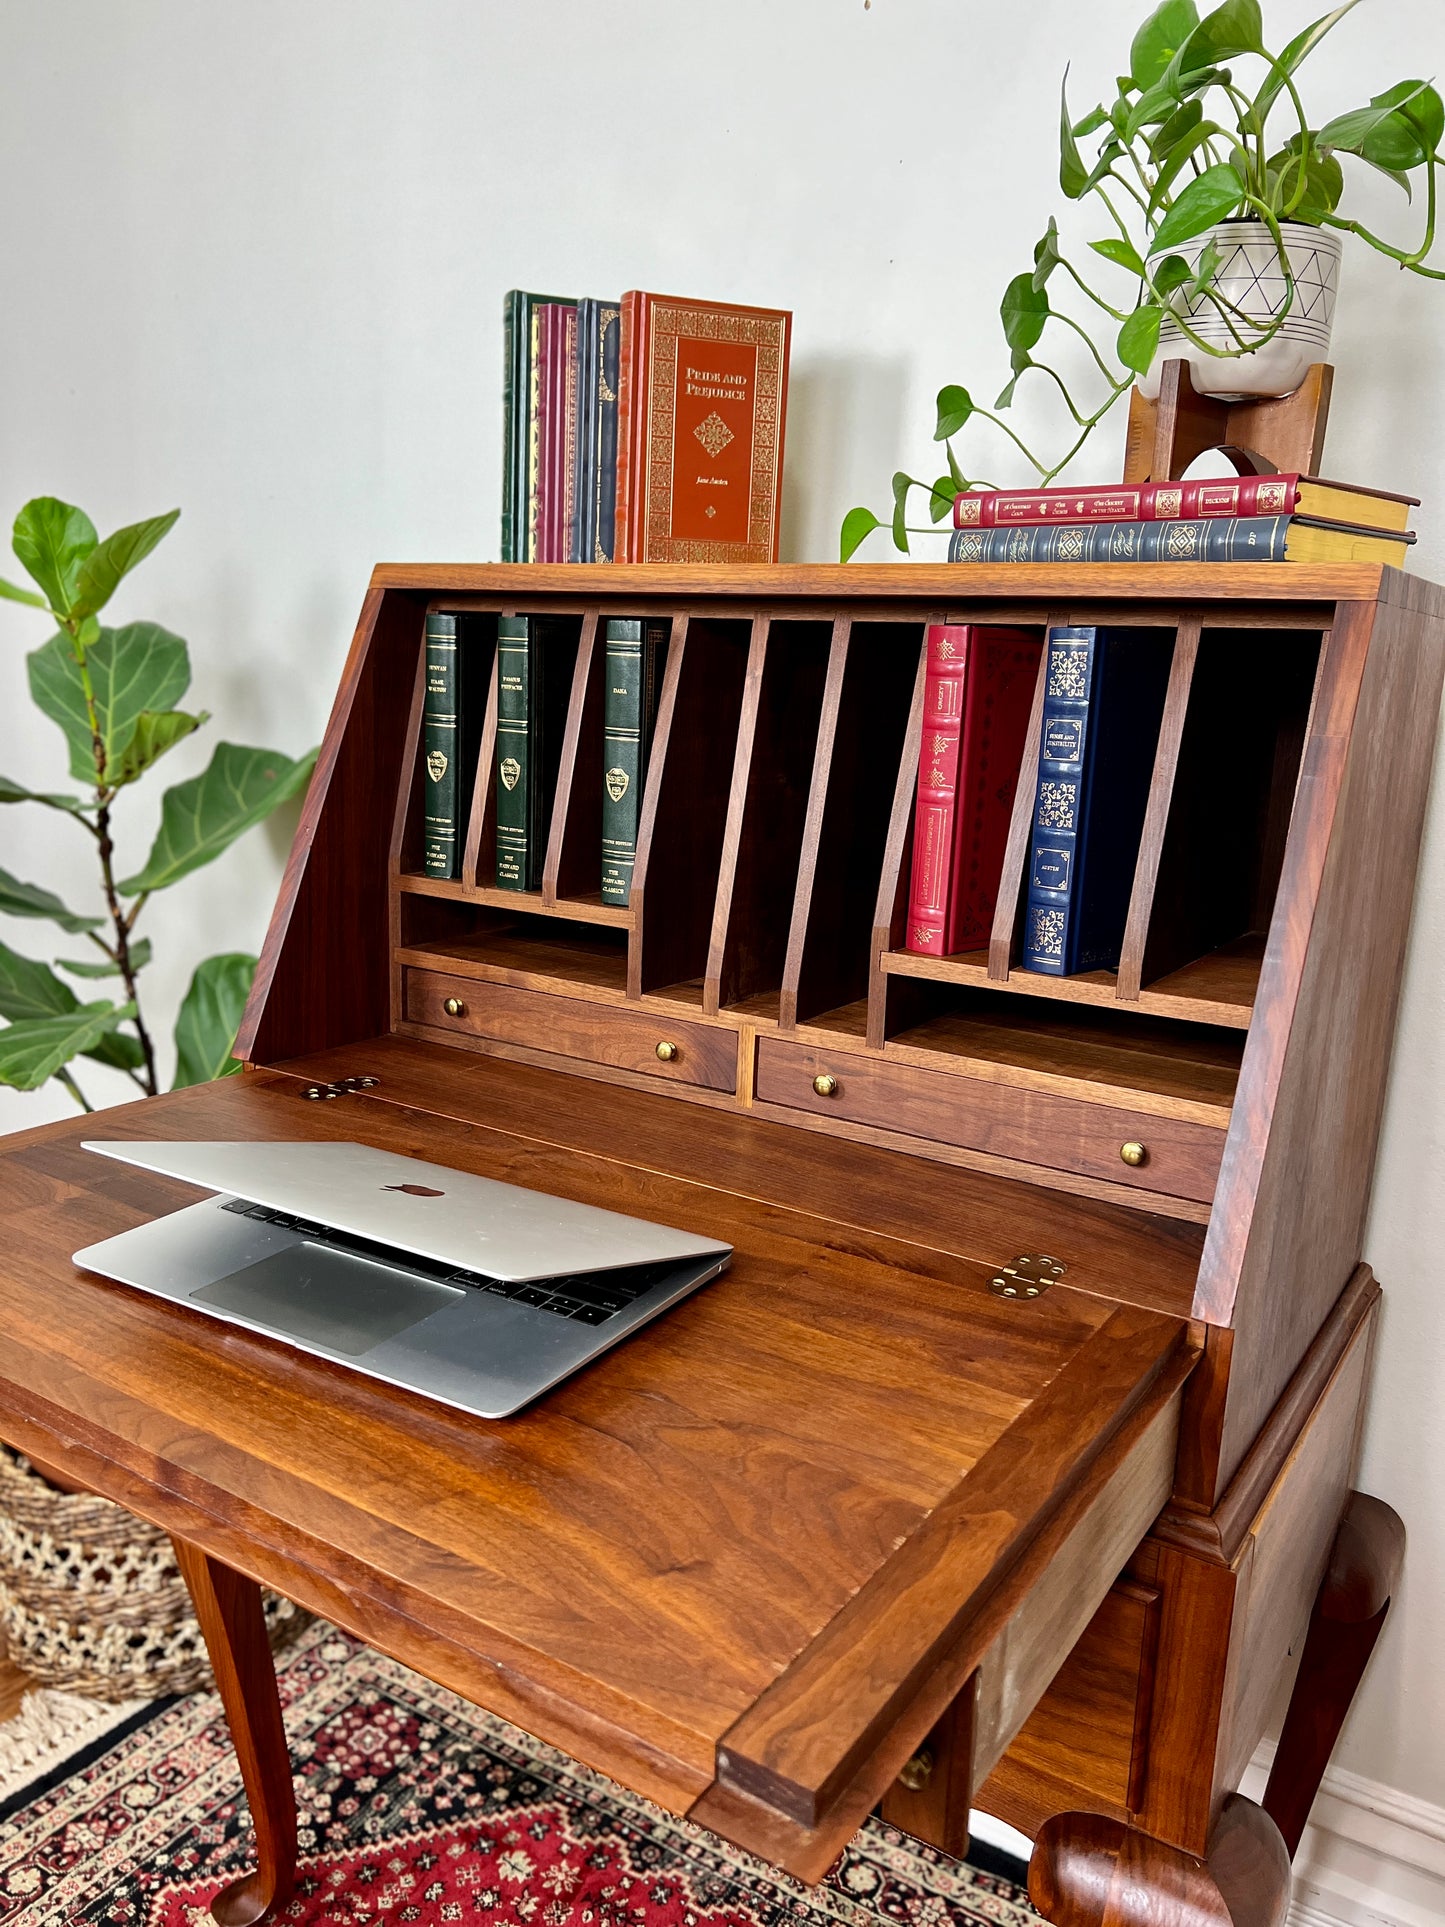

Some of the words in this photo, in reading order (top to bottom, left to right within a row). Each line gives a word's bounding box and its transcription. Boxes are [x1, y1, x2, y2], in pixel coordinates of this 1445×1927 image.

[685, 367, 720, 382] PRIDE
[722, 374, 747, 386] AND
[685, 383, 746, 400] PREJUDICE
[696, 476, 709, 484] Jane
[1248, 531, 1257, 546] DP
[613, 687, 628, 695] DANA
